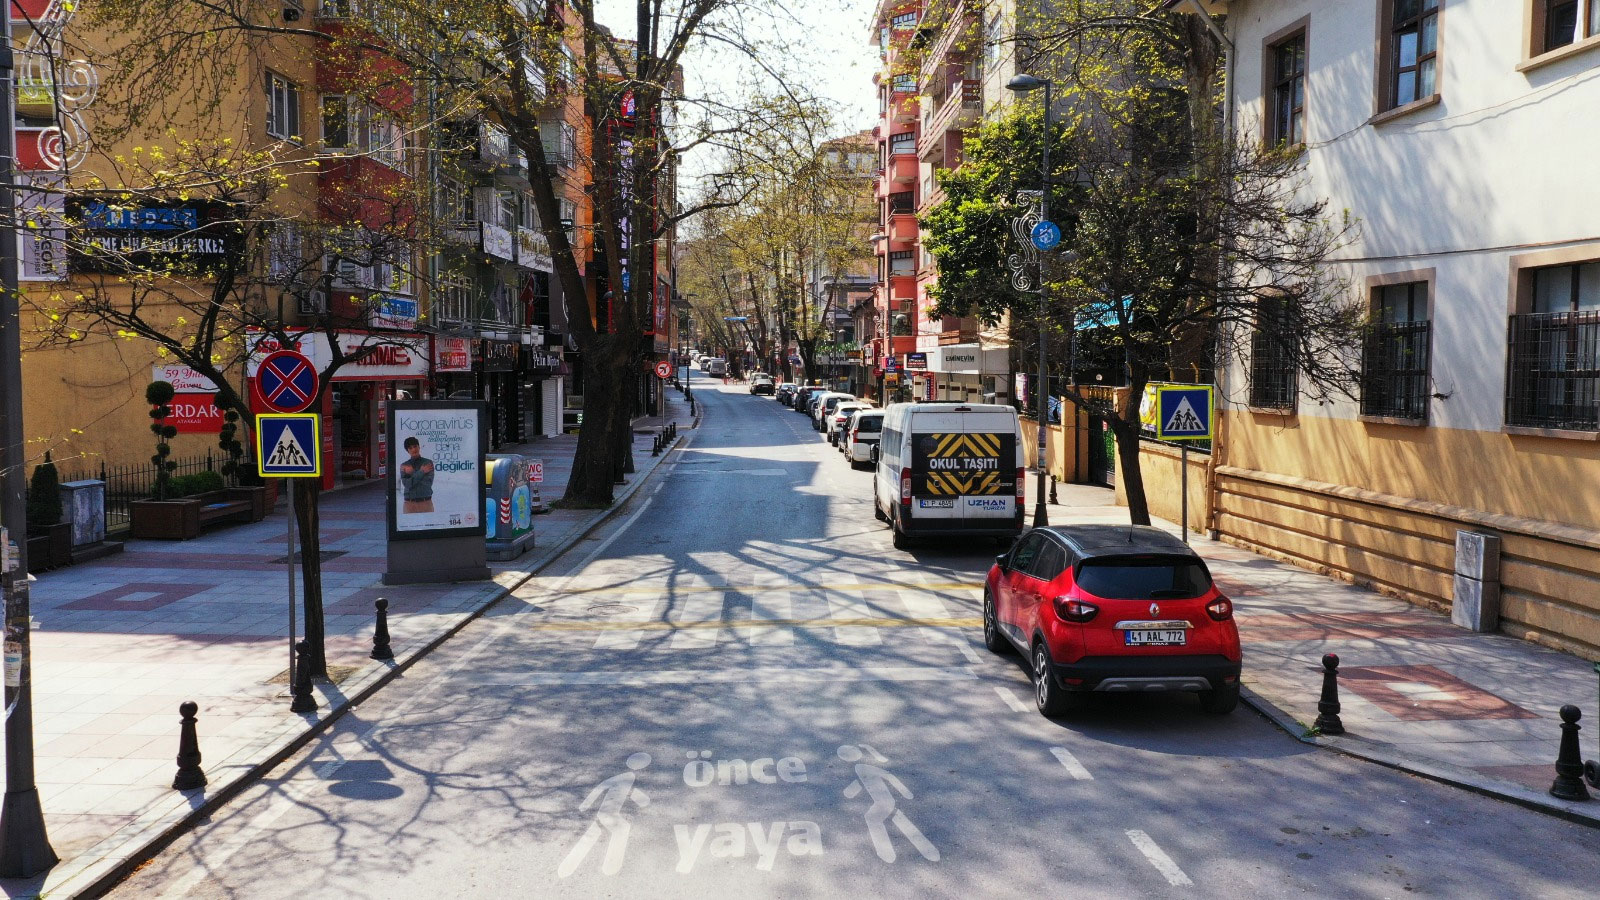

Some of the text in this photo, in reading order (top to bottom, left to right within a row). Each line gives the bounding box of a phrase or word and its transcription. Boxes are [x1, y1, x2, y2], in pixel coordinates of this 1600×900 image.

[945, 354, 975, 363] EMİNEVİM
[165, 369, 179, 378] 59
[165, 404, 220, 418] ERDAR
[400, 417, 474, 430] Koronavirüs
[434, 460, 475, 473] değildir.
[929, 458, 998, 472] OKUL TAŞITI
[968, 499, 1006, 507] UZHAN
[1131, 631, 1183, 642] 41 AAL 772
[682, 749, 808, 788] önce
[673, 820, 824, 875] yaya
